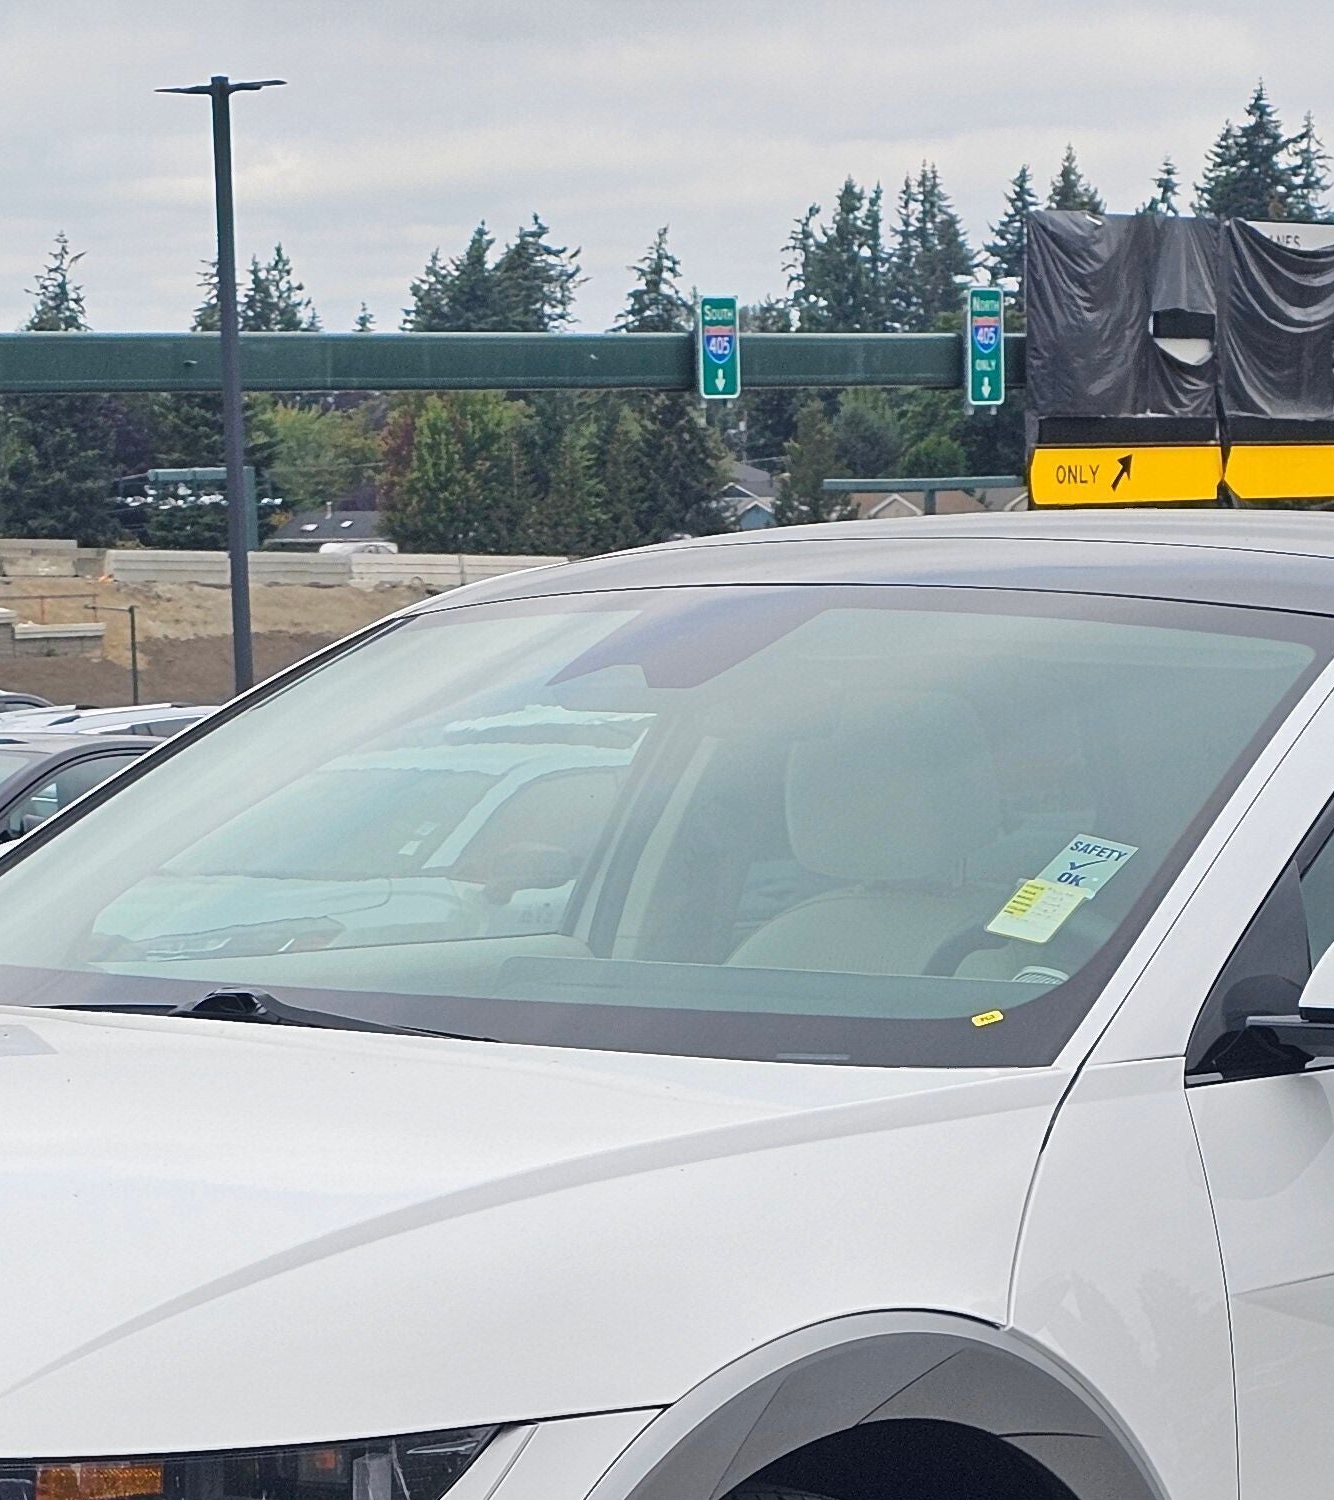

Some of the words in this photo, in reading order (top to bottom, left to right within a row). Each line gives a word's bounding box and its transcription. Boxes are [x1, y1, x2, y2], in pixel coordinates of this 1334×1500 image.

[976, 327, 996, 344] 405
[709, 337, 730, 355] 405
[1056, 464, 1100, 484] ONLY
[1070, 841, 1127, 862] SAFETY
[1057, 872, 1087, 887] OK
